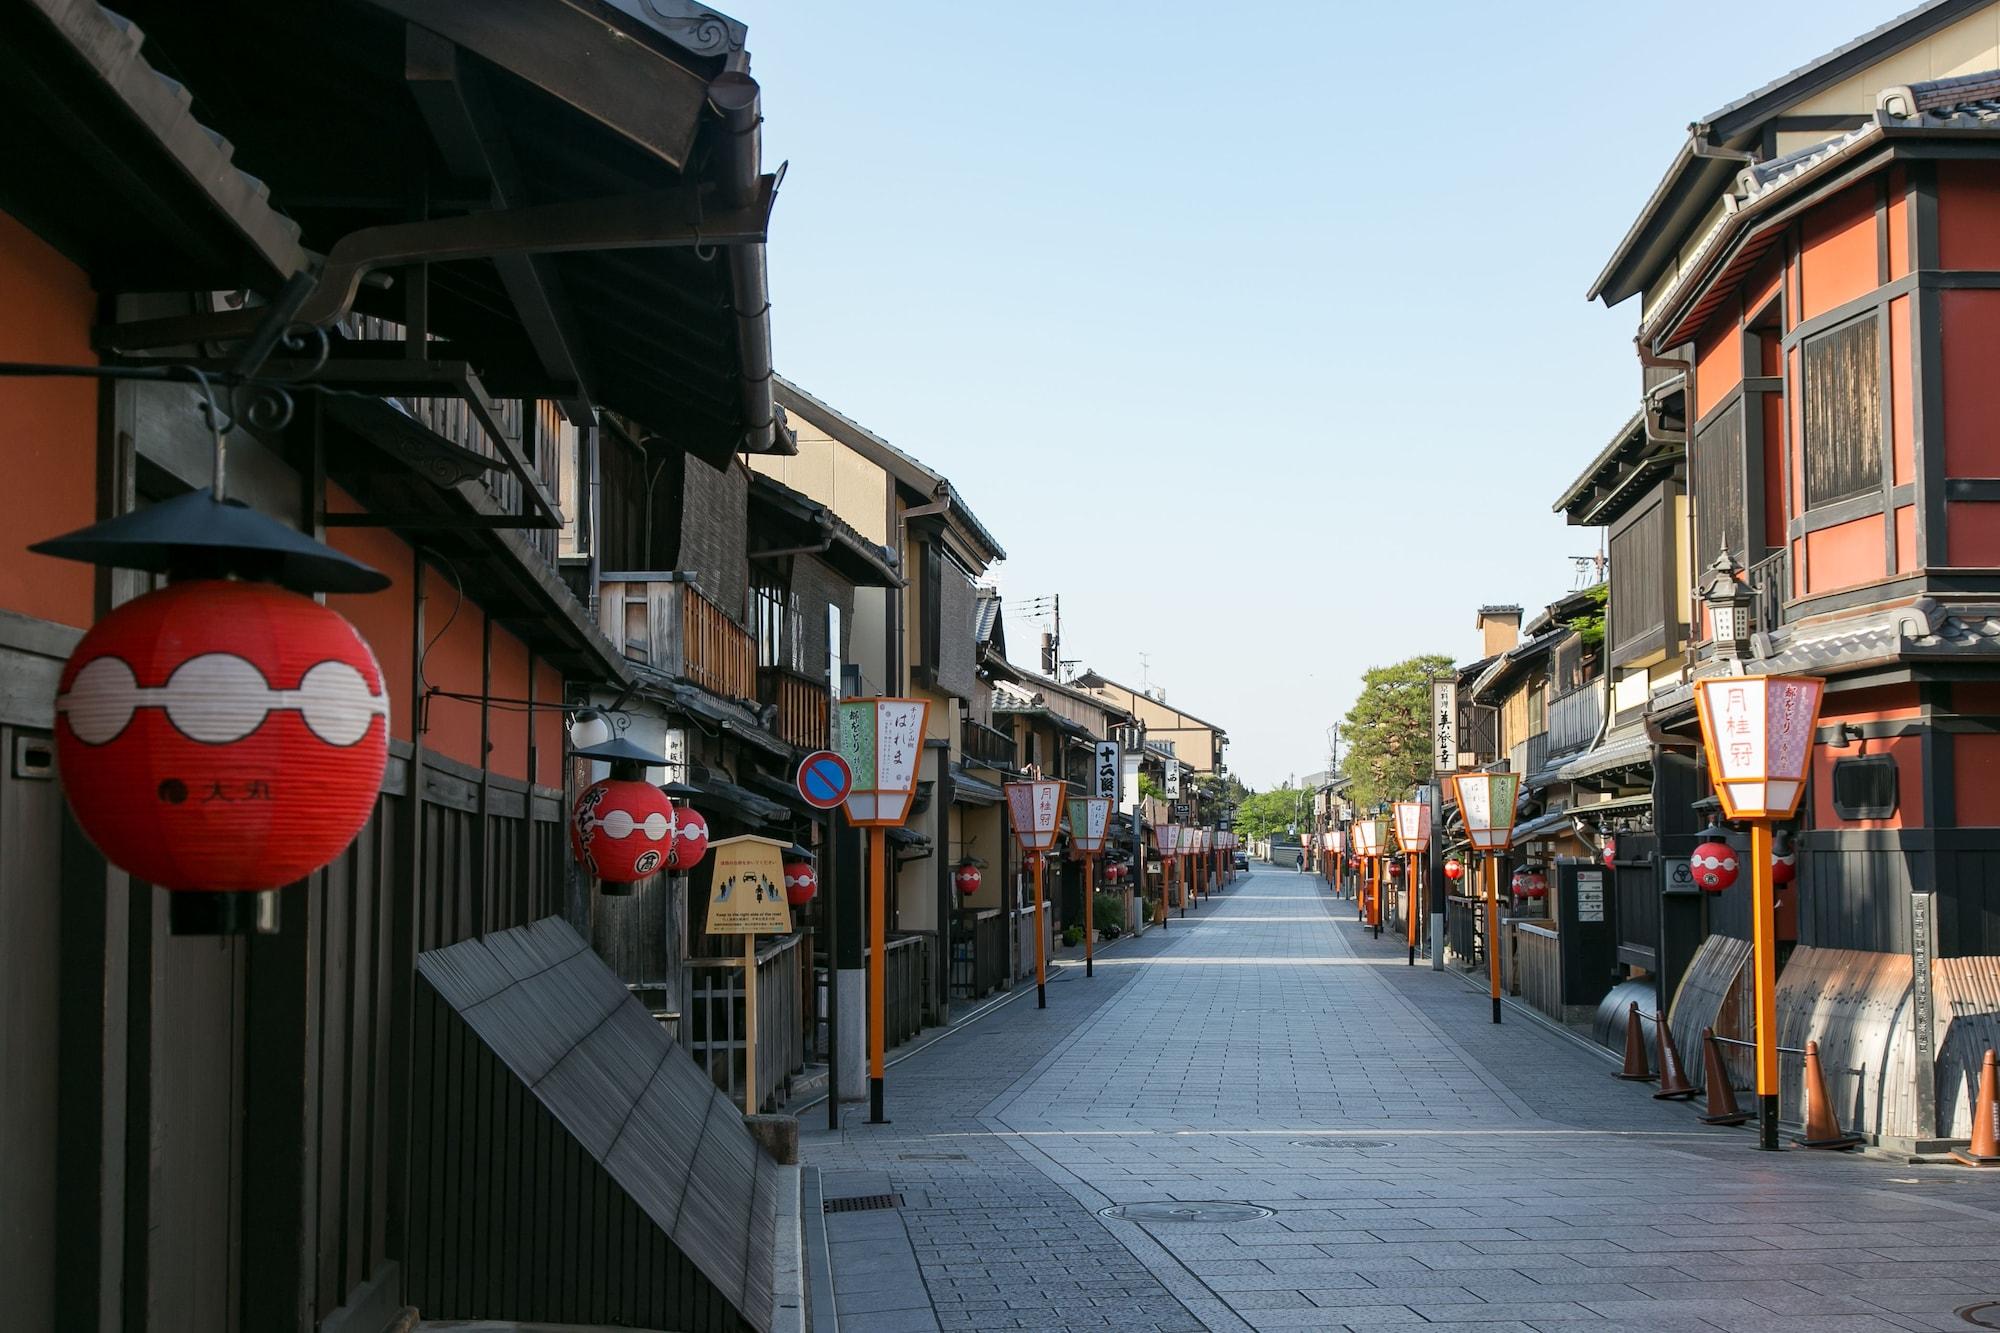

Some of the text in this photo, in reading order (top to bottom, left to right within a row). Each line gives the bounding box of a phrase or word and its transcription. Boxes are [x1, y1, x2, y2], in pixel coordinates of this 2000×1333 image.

[849, 710, 861, 753] 都をどり
[1727, 688, 1752, 767] 月桂冠
[1783, 687, 1797, 734] 都をどり
[893, 714, 907, 765] はれま
[1040, 787, 1051, 826] 月桂冠
